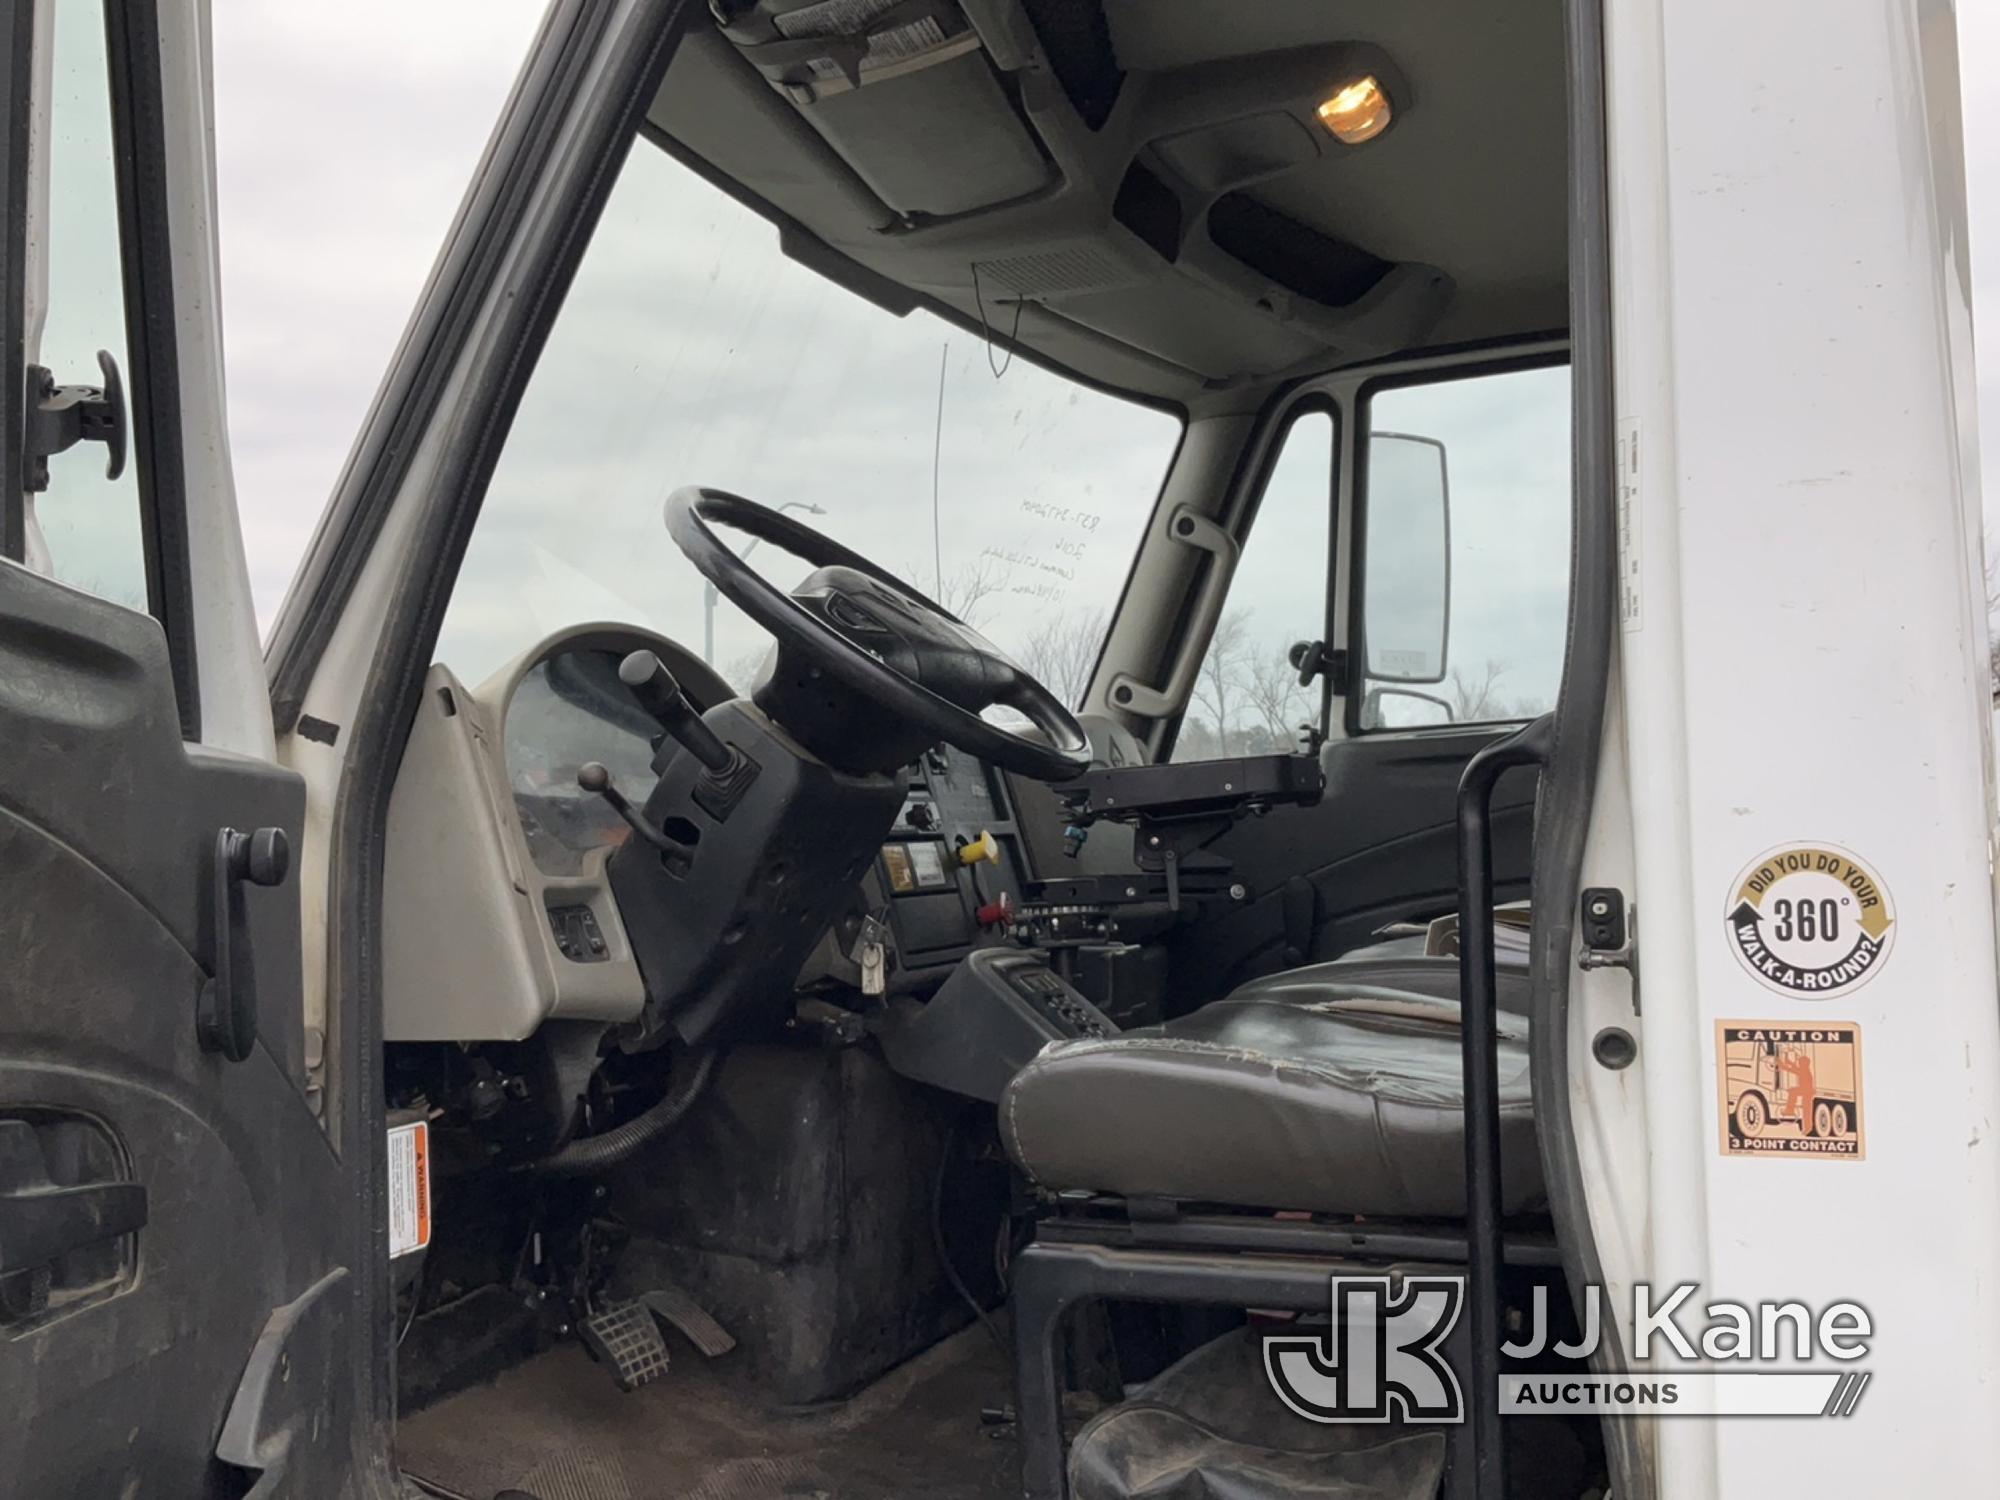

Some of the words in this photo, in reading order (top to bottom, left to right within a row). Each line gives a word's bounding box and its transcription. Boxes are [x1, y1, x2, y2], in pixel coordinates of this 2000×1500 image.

[1748, 866, 1775, 894] DID
[1778, 853, 1811, 875] YOU
[1816, 854, 1840, 875] DO
[1842, 867, 1879, 910] YOUR
[1737, 923, 1879, 989] WALK-A-ROUND?
[1737, 1030, 1840, 1042] CAUTION
[1732, 1139, 1740, 1148] 3
[1744, 1139, 1786, 1150] POINT
[1789, 1140, 1855, 1152] CONTACT
